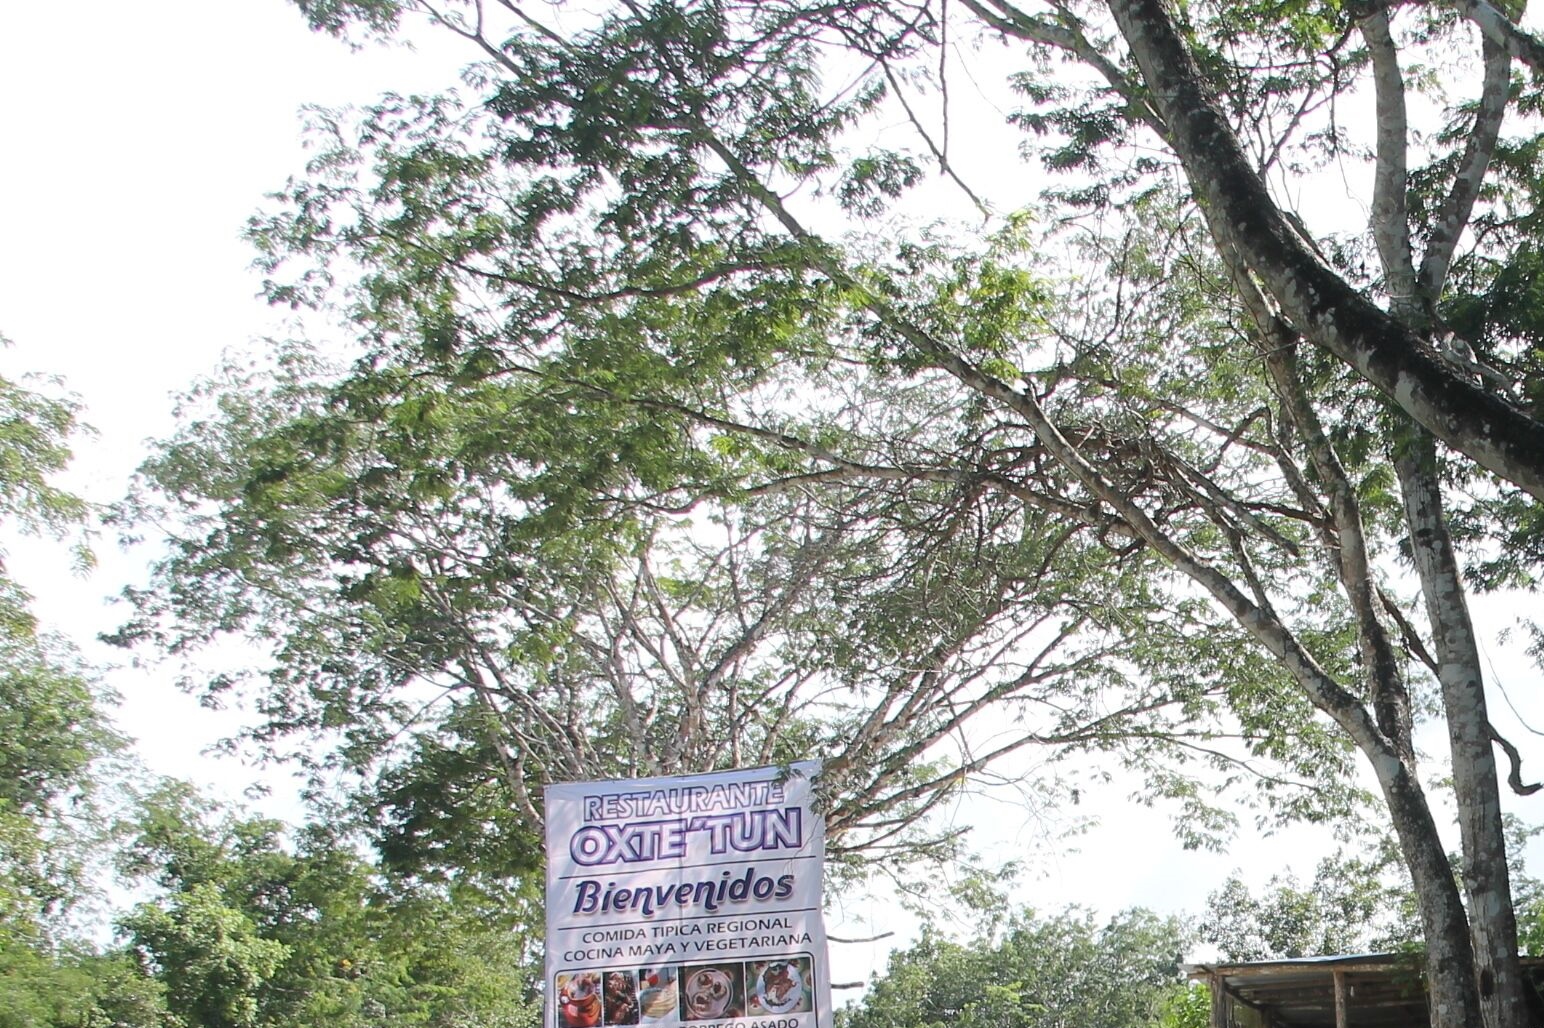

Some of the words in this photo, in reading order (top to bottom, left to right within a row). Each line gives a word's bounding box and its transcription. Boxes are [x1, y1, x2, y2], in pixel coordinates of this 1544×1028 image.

[584, 780, 784, 822] RESTAURANTE
[573, 868, 795, 915] Bienvenidos
[563, 947, 623, 962] COCINA
[628, 943, 675, 956] MAYA
[679, 941, 690, 953] Y
[694, 932, 812, 951] VEGETARIANA
[582, 929, 646, 944] COMIDA
[651, 923, 701, 938] TIPICA
[707, 917, 793, 934] REGIONAL
